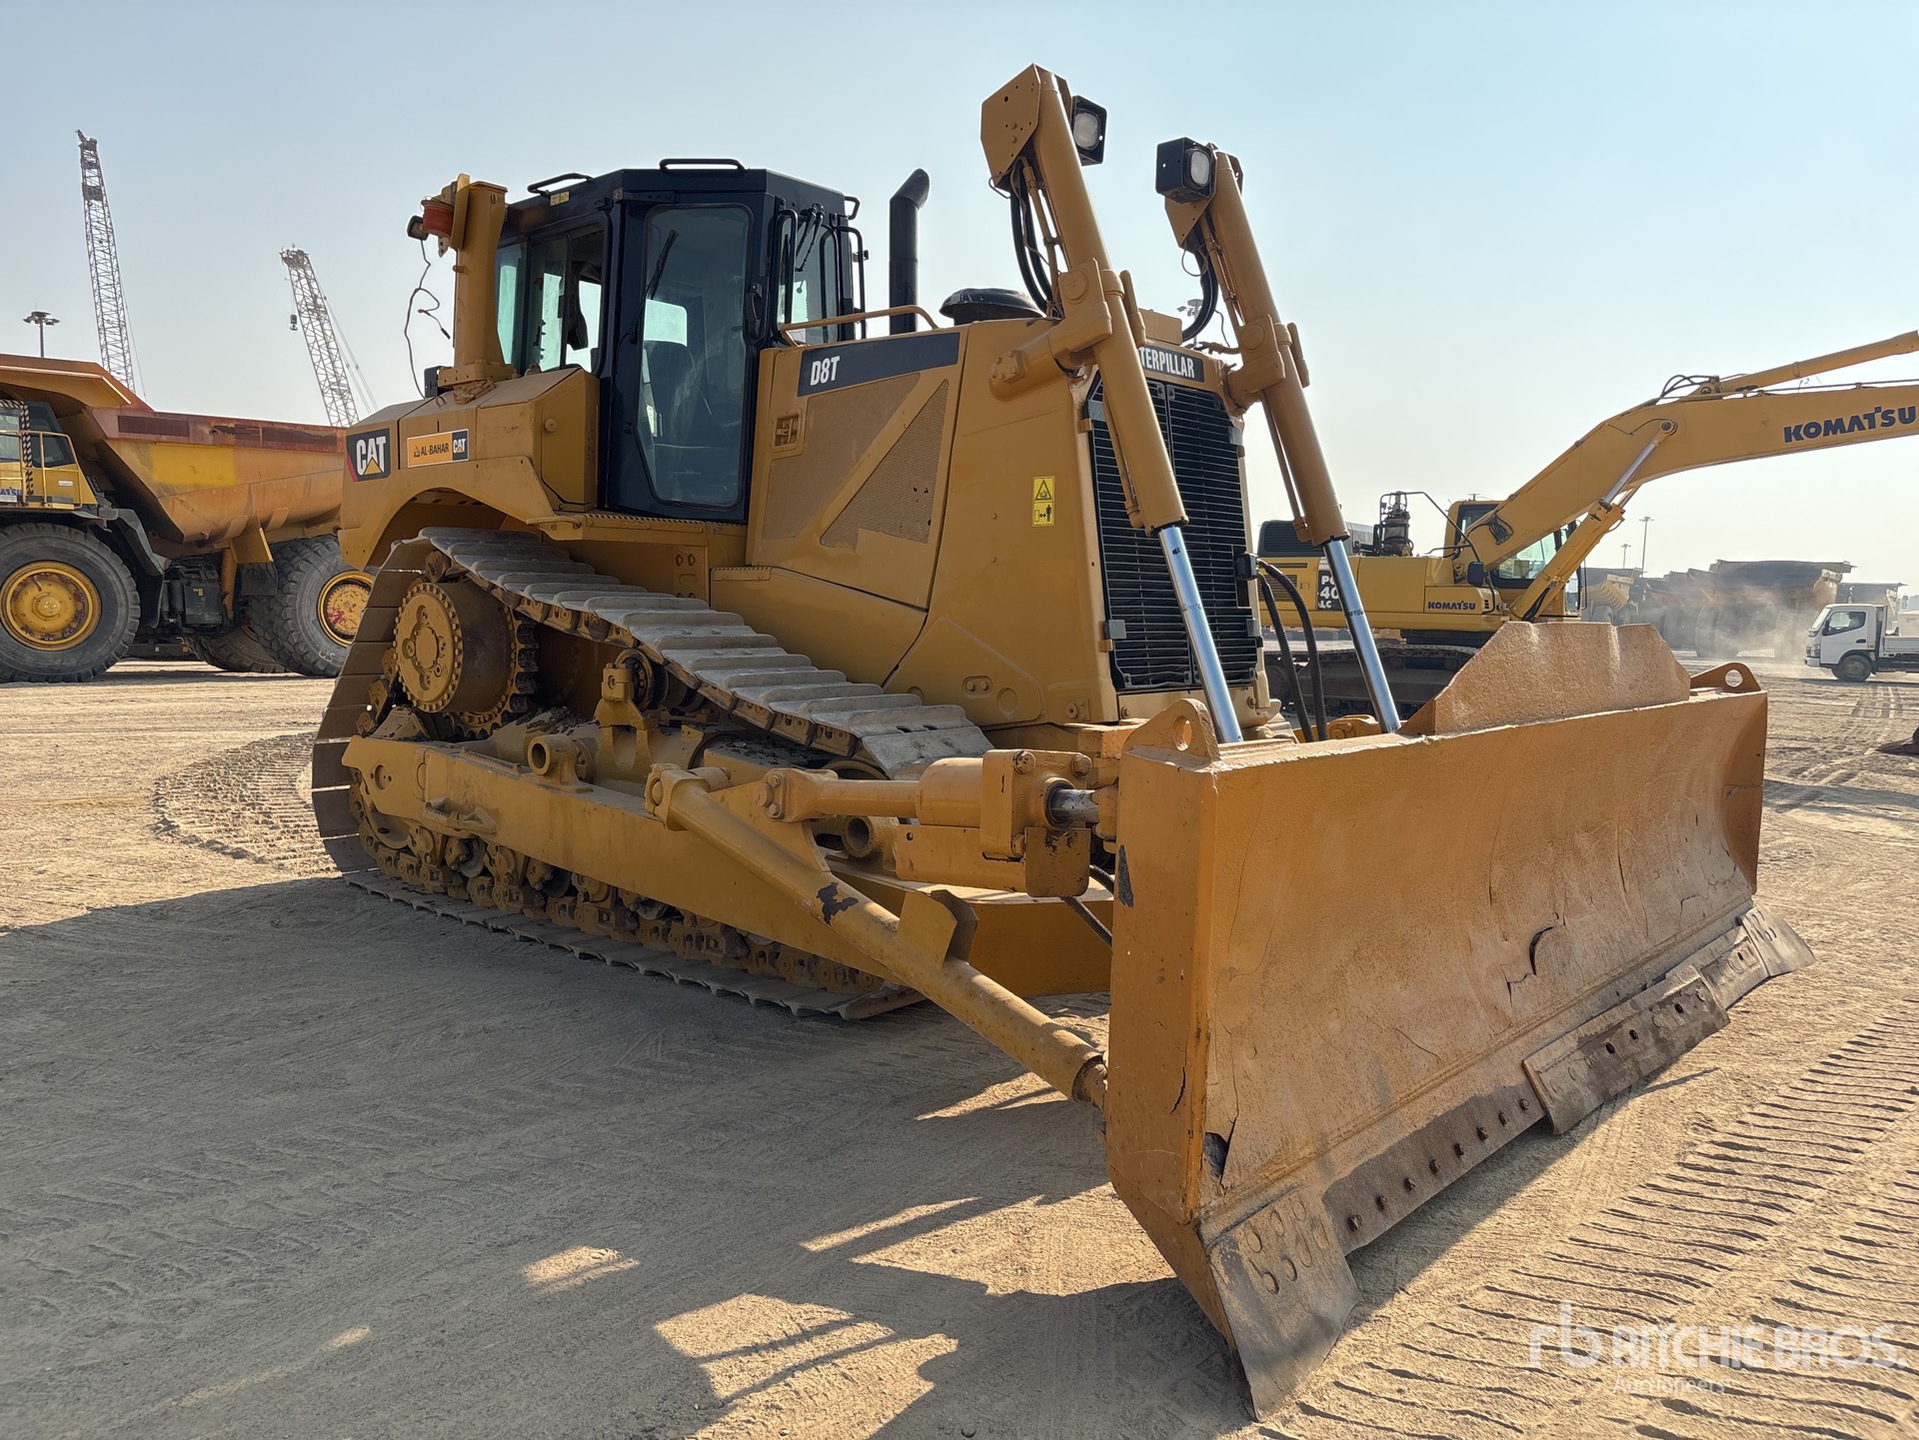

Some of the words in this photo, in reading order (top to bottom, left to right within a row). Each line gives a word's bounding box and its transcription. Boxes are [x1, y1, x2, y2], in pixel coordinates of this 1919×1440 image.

[1139, 347, 1195, 379] TERPILLAR
[810, 355, 841, 387] D8T
[1783, 405, 1917, 443] KOMATSU
[420, 442, 450, 456] AL-BAHAR
[452, 438, 466, 454] CAT
[356, 435, 387, 476] CAT
[0, 486, 23, 496] ATSU
[1319, 586, 1340, 600] 40
[1317, 600, 1332, 609] LC
[1427, 600, 1476, 611] KOMATSU
